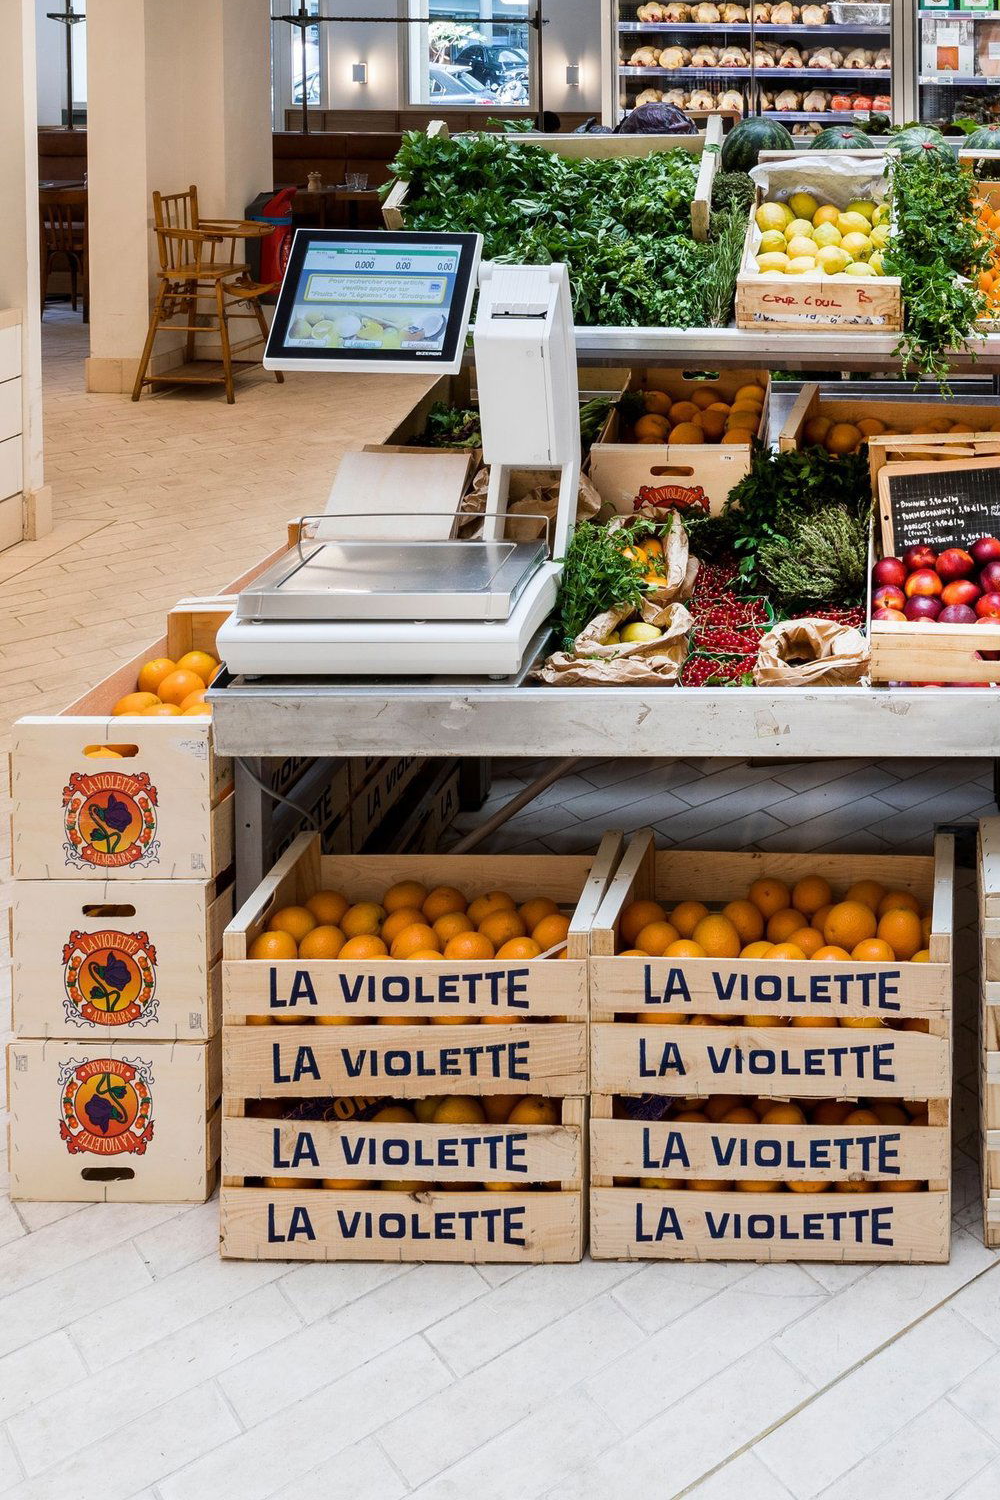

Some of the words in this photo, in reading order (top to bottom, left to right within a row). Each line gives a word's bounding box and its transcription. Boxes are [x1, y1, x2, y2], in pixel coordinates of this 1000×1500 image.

[660, 488, 696, 503] VIOLETTE
[81, 780, 97, 796] LA
[96, 775, 139, 795] VIOLETTE
[91, 852, 134, 865] ALMENARA
[81, 938, 97, 953] LA
[95, 933, 139, 953] VIOLETTE
[269, 967, 318, 1008] LA
[339, 968, 530, 1010] VIOLETTE
[644, 964, 692, 1005] LA
[712, 970, 901, 1011] VIOLETTE
[91, 1011, 133, 1024] ALMENARA
[84, 1061, 125, 1074] ALMENARA
[272, 1043, 322, 1084] LA
[340, 1041, 531, 1081] VIOLETTE
[639, 1038, 687, 1078] LA
[706, 1042, 896, 1082] VIOLETTE
[77, 1132, 122, 1152] VIOLETTE
[121, 1132, 136, 1147] LA
[272, 1127, 320, 1169] LA
[340, 1133, 528, 1173] VIOLETTE
[643, 1127, 691, 1169] LA
[710, 1133, 901, 1175] VIOLETTE
[268, 1203, 317, 1243] LA
[336, 1206, 526, 1247] VIOLETTE
[635, 1202, 684, 1242] LA
[704, 1206, 894, 1247] VIOLETTE
